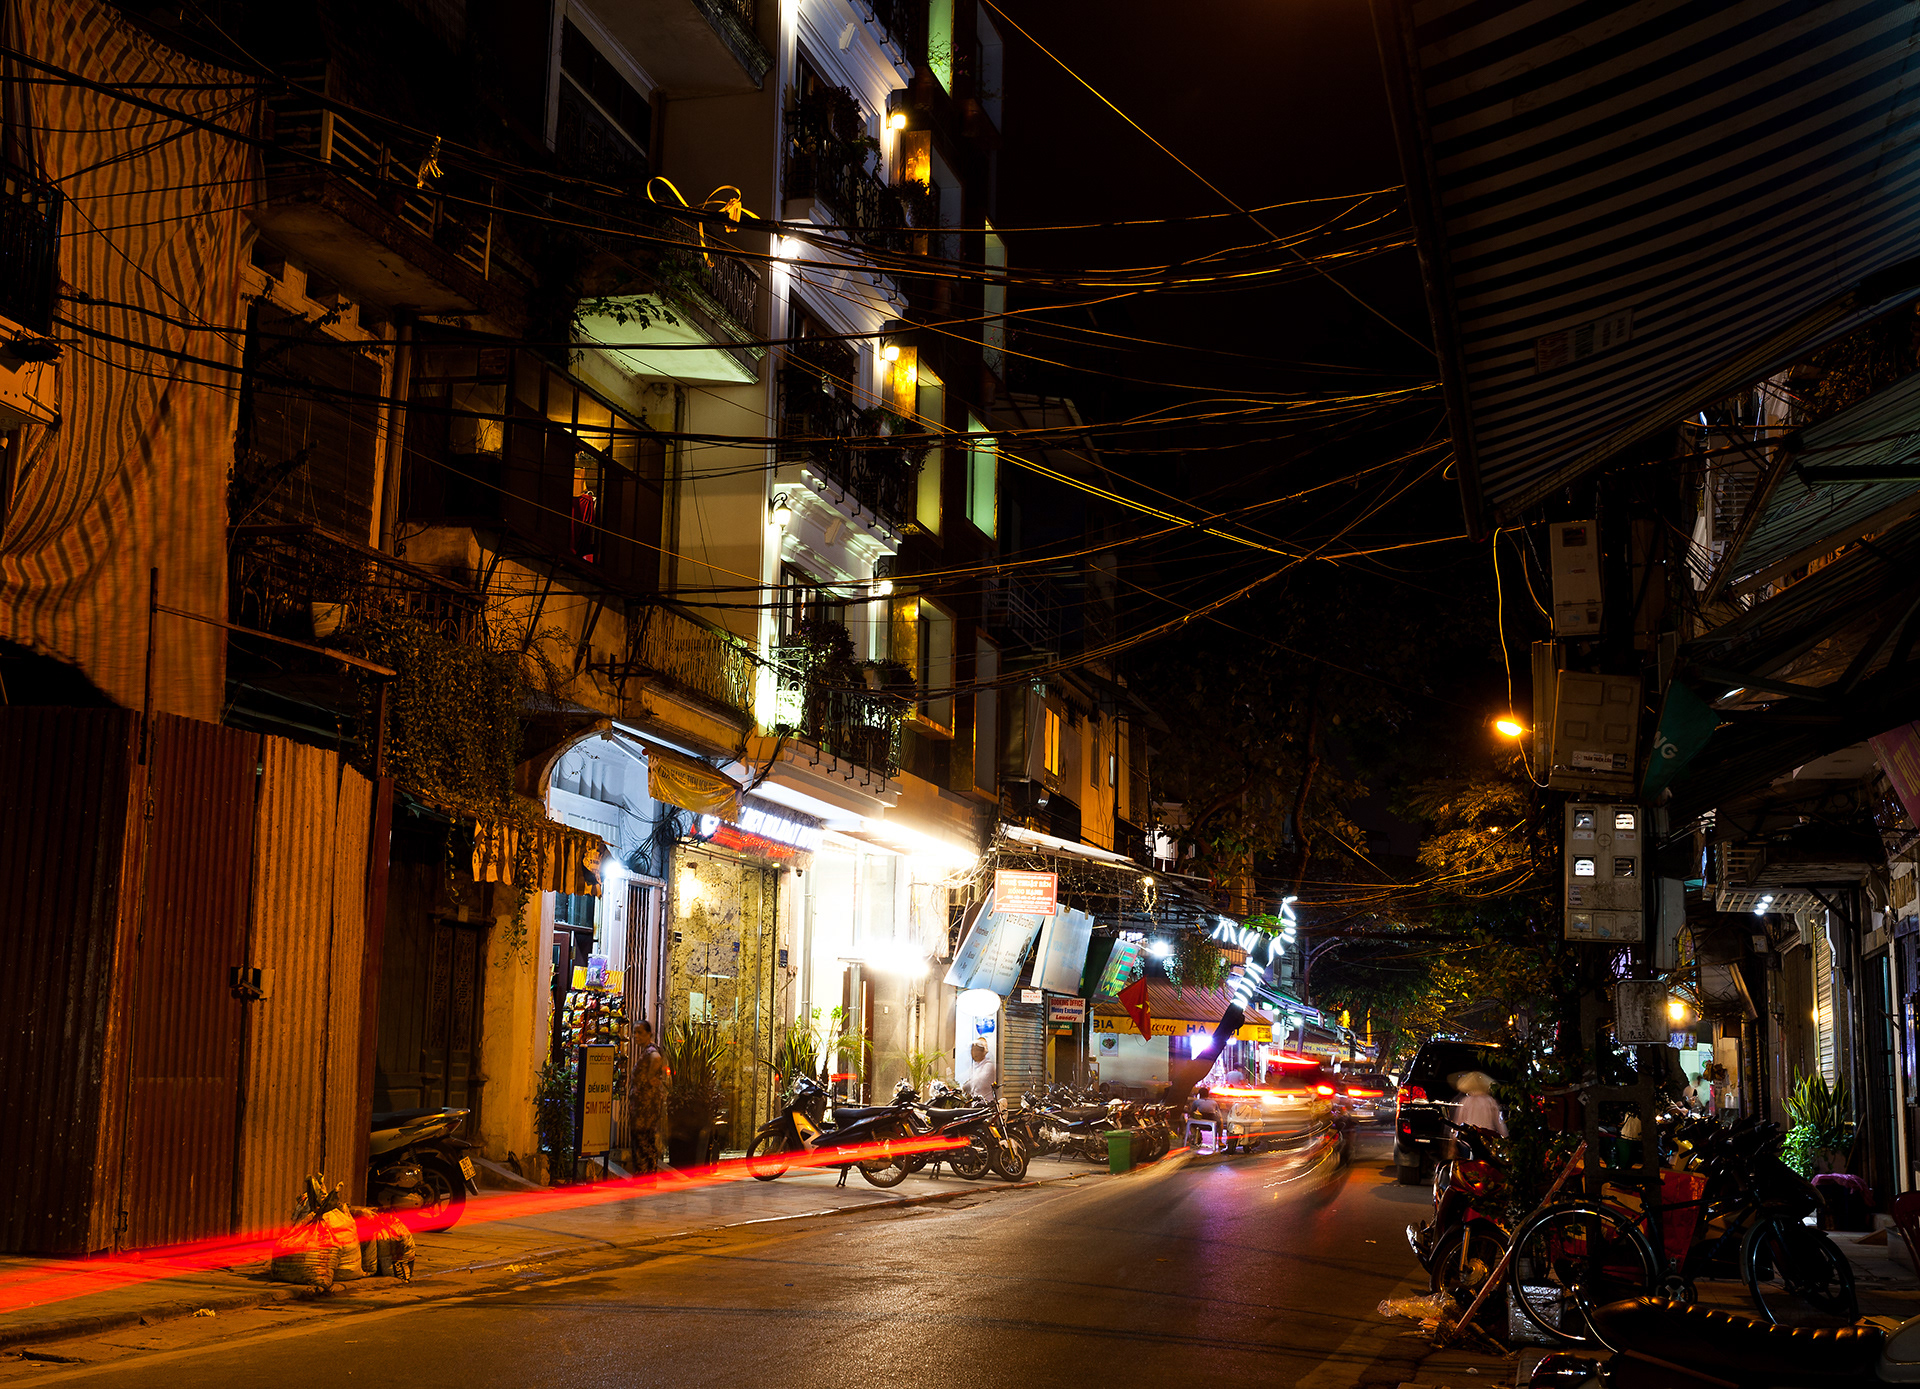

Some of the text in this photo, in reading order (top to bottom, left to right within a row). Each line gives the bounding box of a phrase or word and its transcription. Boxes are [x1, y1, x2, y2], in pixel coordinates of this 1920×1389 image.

[1050, 998, 1084, 1007] BOOKING OFFICE
[1051, 1006, 1083, 1015] Money Exchange
[589, 1052, 612, 1061] mobifone
[585, 1102, 598, 1114] SIM
